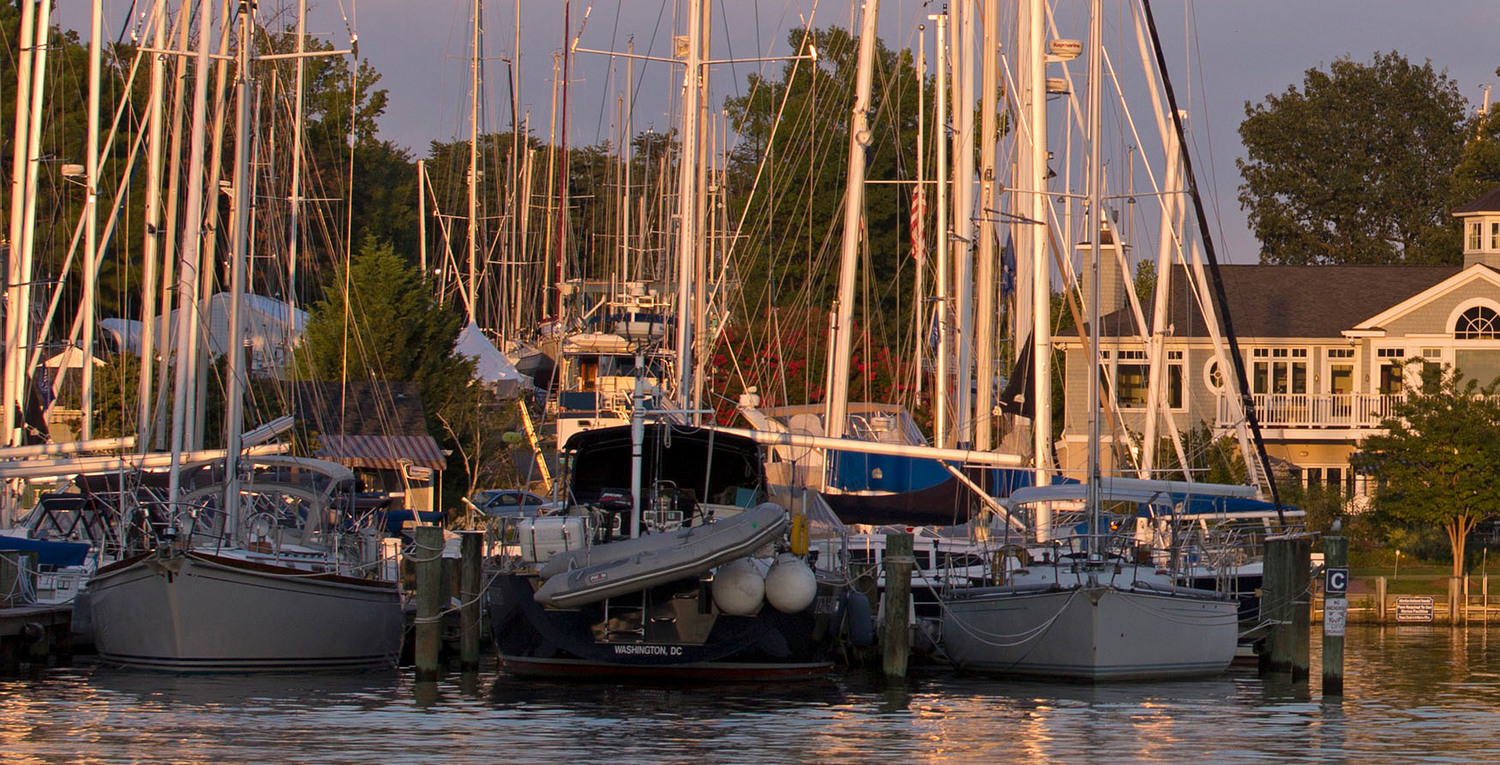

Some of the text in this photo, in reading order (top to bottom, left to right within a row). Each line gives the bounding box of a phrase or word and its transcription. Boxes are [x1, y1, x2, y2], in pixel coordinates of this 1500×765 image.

[1331, 572, 1345, 589] C
[614, 645, 683, 656] WASHINGTON, DC
